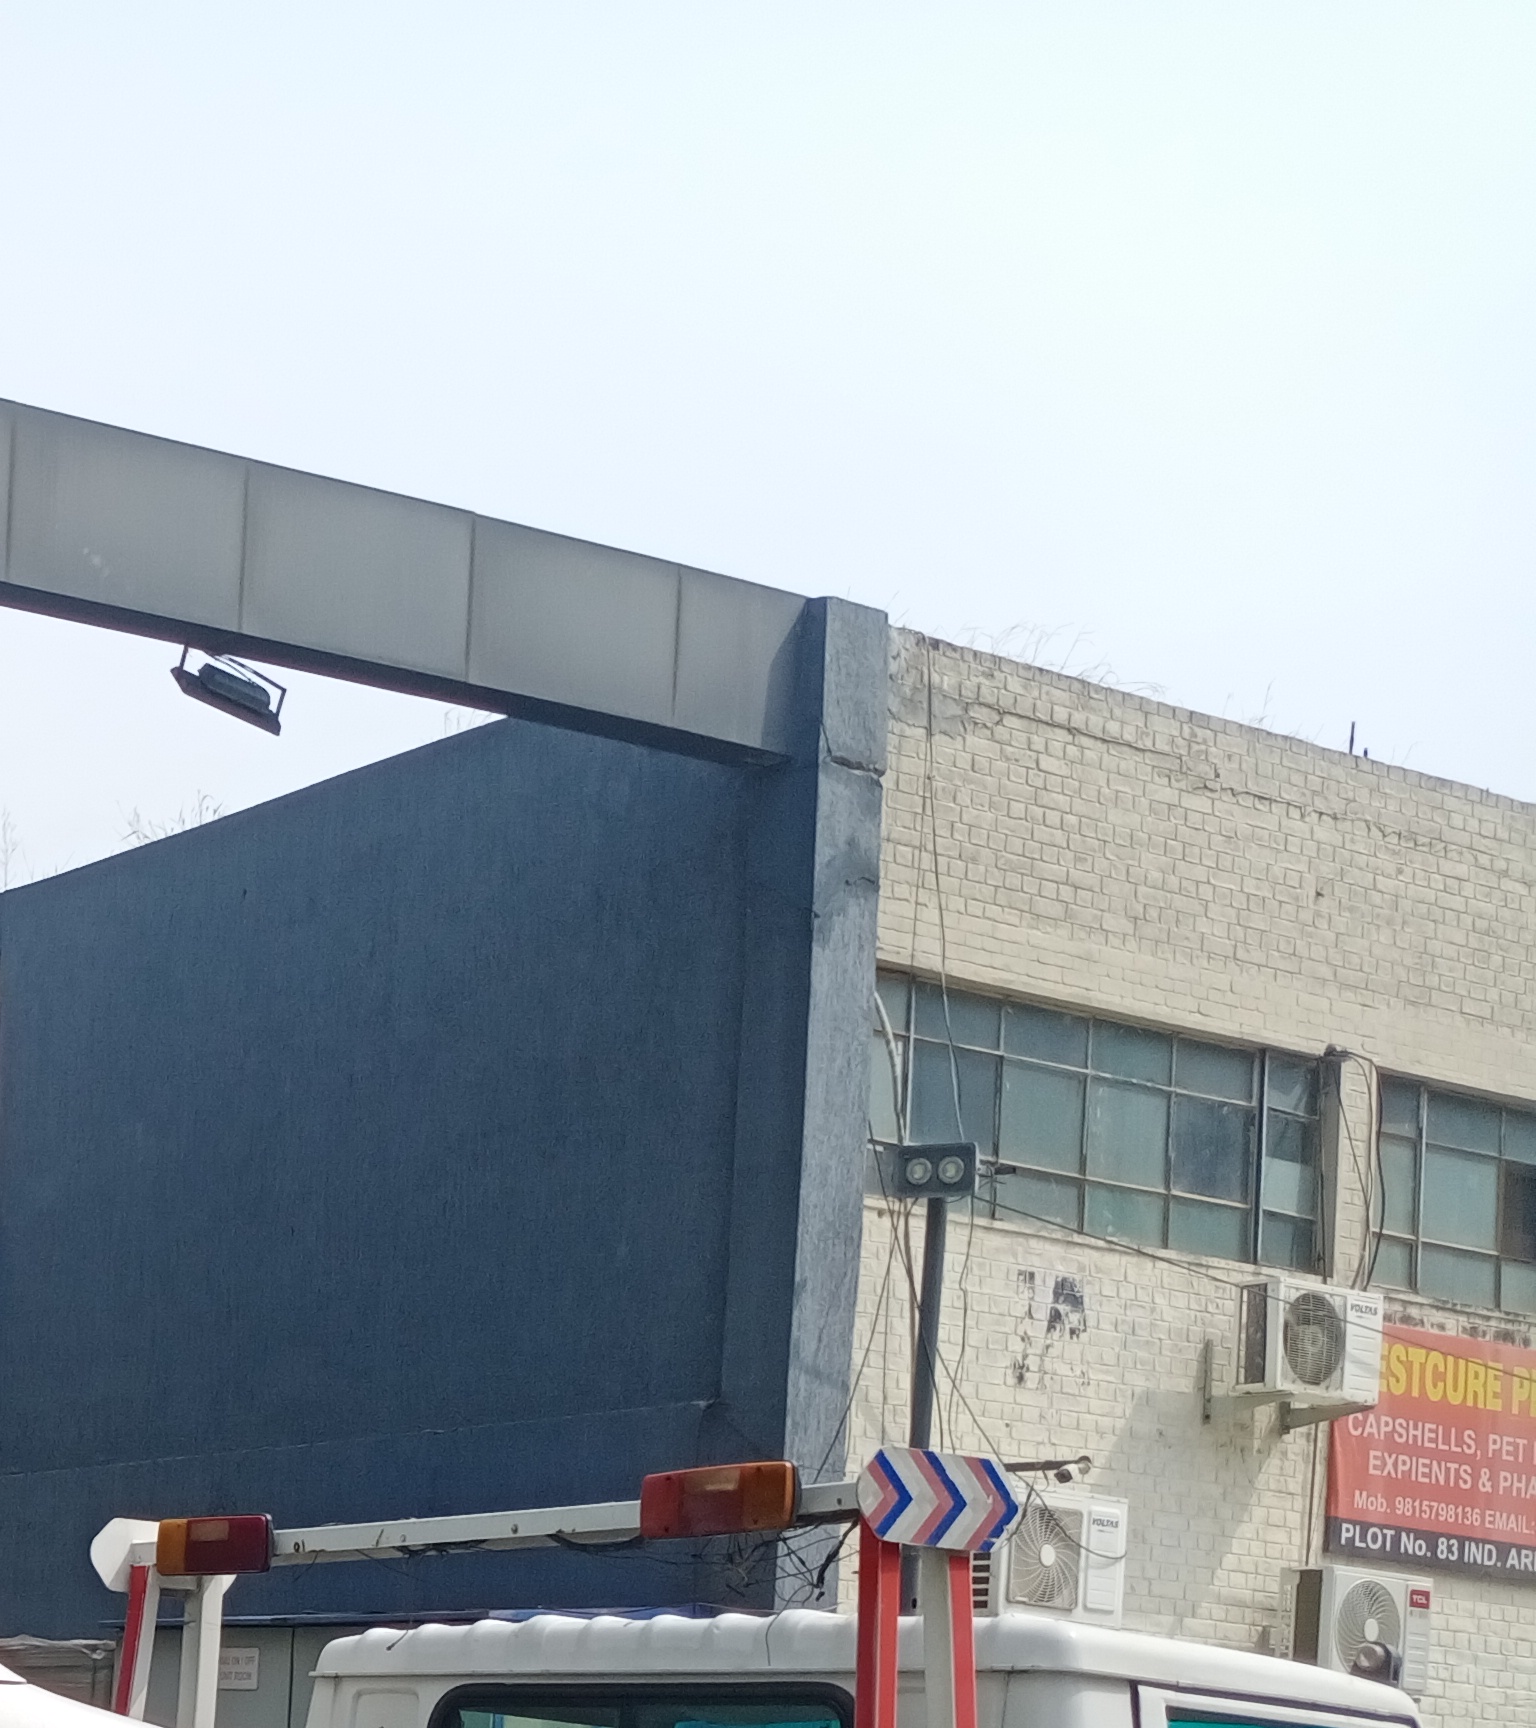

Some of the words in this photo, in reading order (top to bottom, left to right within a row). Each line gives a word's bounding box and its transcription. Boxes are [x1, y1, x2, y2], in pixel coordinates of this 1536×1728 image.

[1350, 1303, 1378, 1316] VOLTAS
[1348, 1412, 1481, 1460] CAPSHELLS,
[1488, 1433, 1528, 1463] PET
[1368, 1450, 1473, 1490] EXPIENTS
[1478, 1467, 1493, 1494] &
[1354, 1489, 1391, 1513] Mob.
[1395, 1496, 1481, 1527] 9815798136
[1340, 1523, 1395, 1552] PLOT
[1400, 1532, 1431, 1558] No.
[1436, 1537, 1459, 1561] 83
[1463, 1541, 1502, 1568] IND.
[1506, 1548, 1536, 1572] AR
[1412, 1594, 1428, 1604] TCL
